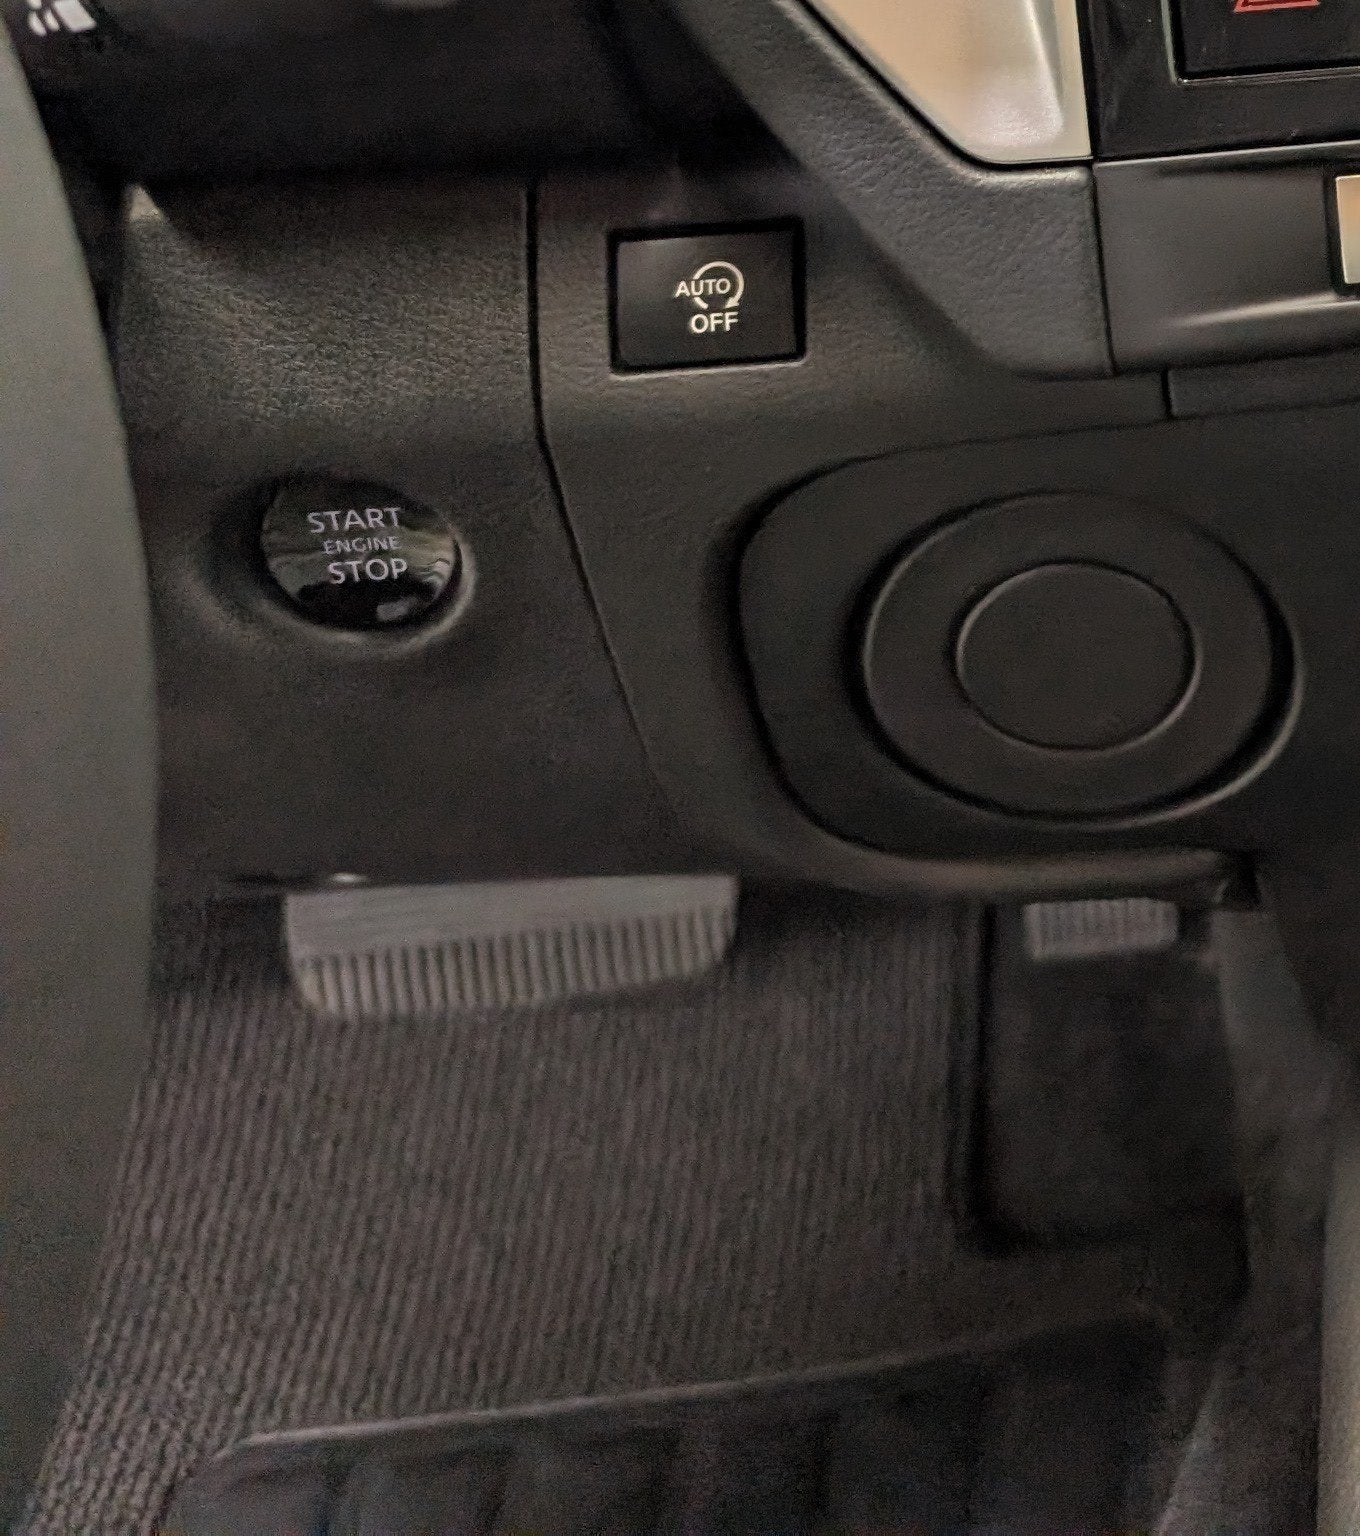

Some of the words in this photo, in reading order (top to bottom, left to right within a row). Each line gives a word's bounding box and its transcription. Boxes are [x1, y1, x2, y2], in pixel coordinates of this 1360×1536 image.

[674, 275, 731, 299] AUTO
[690, 312, 739, 334] OFF
[307, 507, 403, 532] START
[324, 535, 399, 556] ENGINE
[327, 559, 408, 584] STOP
